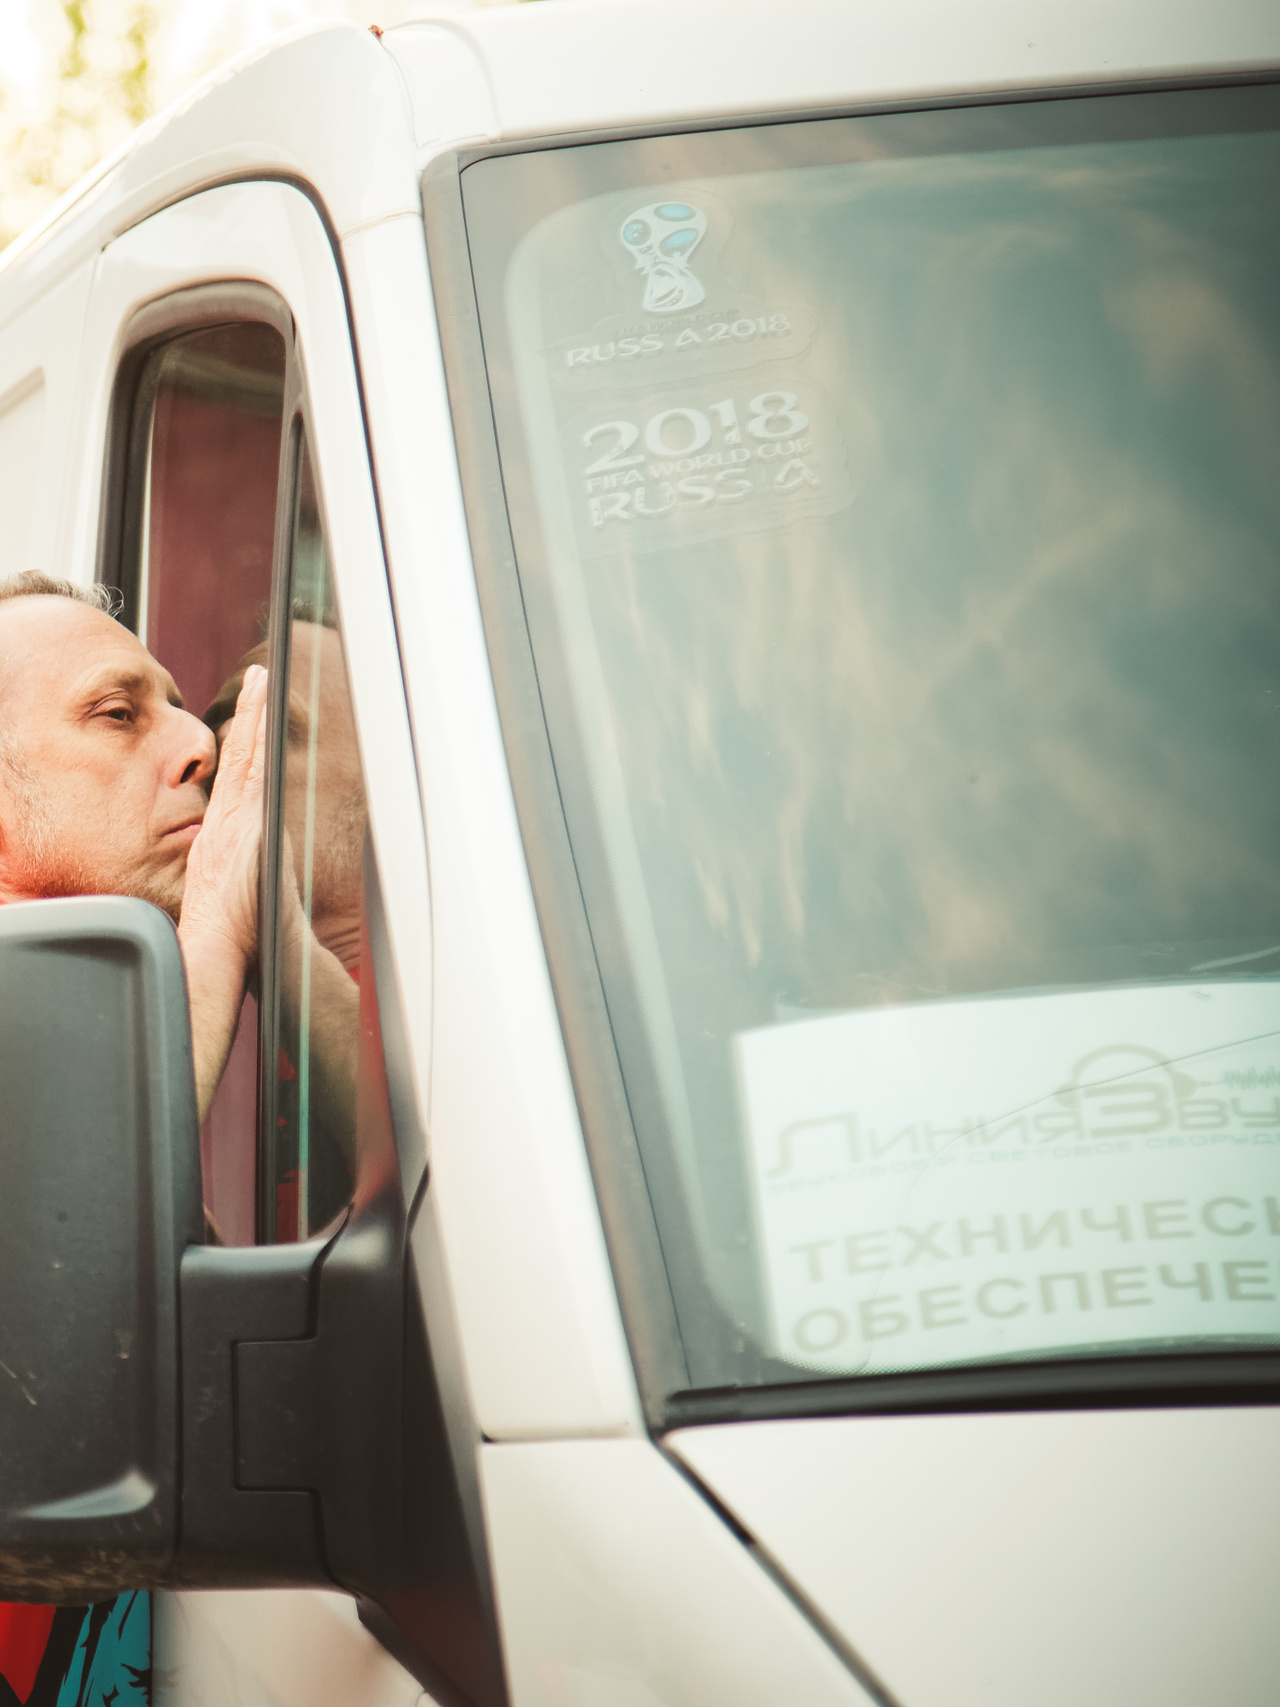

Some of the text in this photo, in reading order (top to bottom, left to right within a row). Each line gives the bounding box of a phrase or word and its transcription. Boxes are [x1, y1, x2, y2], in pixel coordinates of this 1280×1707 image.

[706, 308, 741, 323] CUP
[706, 313, 792, 342] 2018
[581, 390, 810, 476] 2018
[586, 468, 645, 494] FIFA
[649, 447, 752, 479] WORLD
[1145, 1132, 1280, 1150] ОБОРУД
